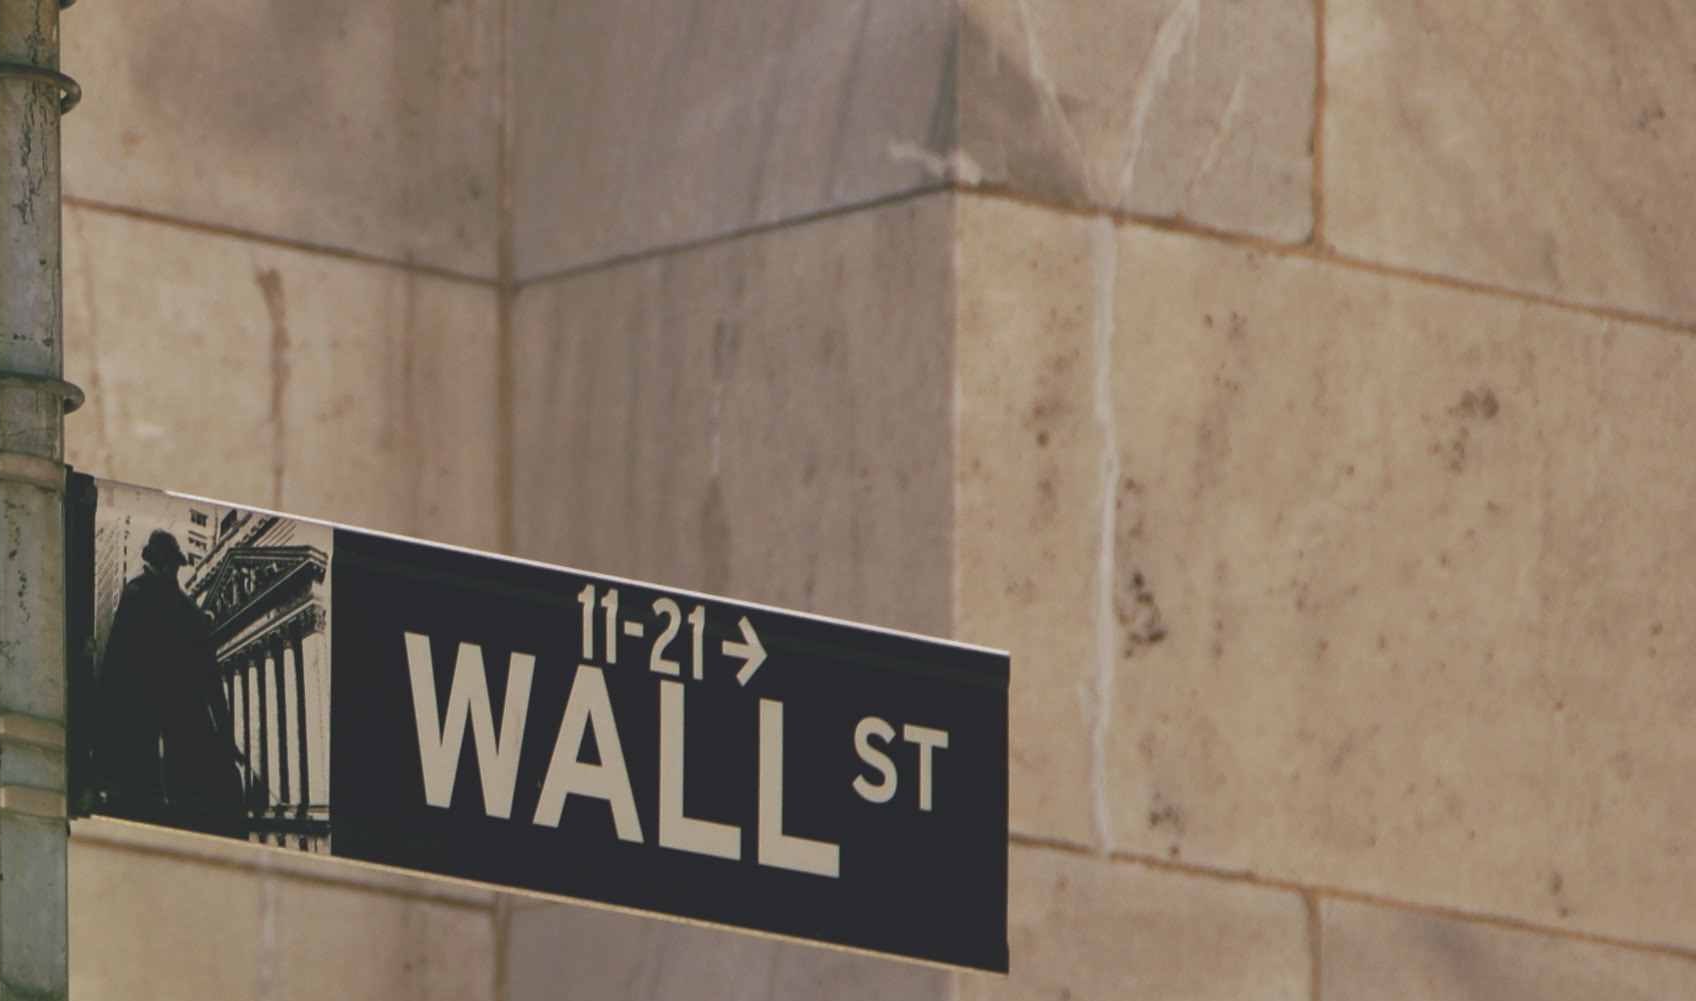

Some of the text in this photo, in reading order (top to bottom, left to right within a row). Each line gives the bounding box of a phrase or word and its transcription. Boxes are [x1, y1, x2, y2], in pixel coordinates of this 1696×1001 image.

[576, 583, 705, 681] 11-21
[404, 631, 949, 879] WALL ST
